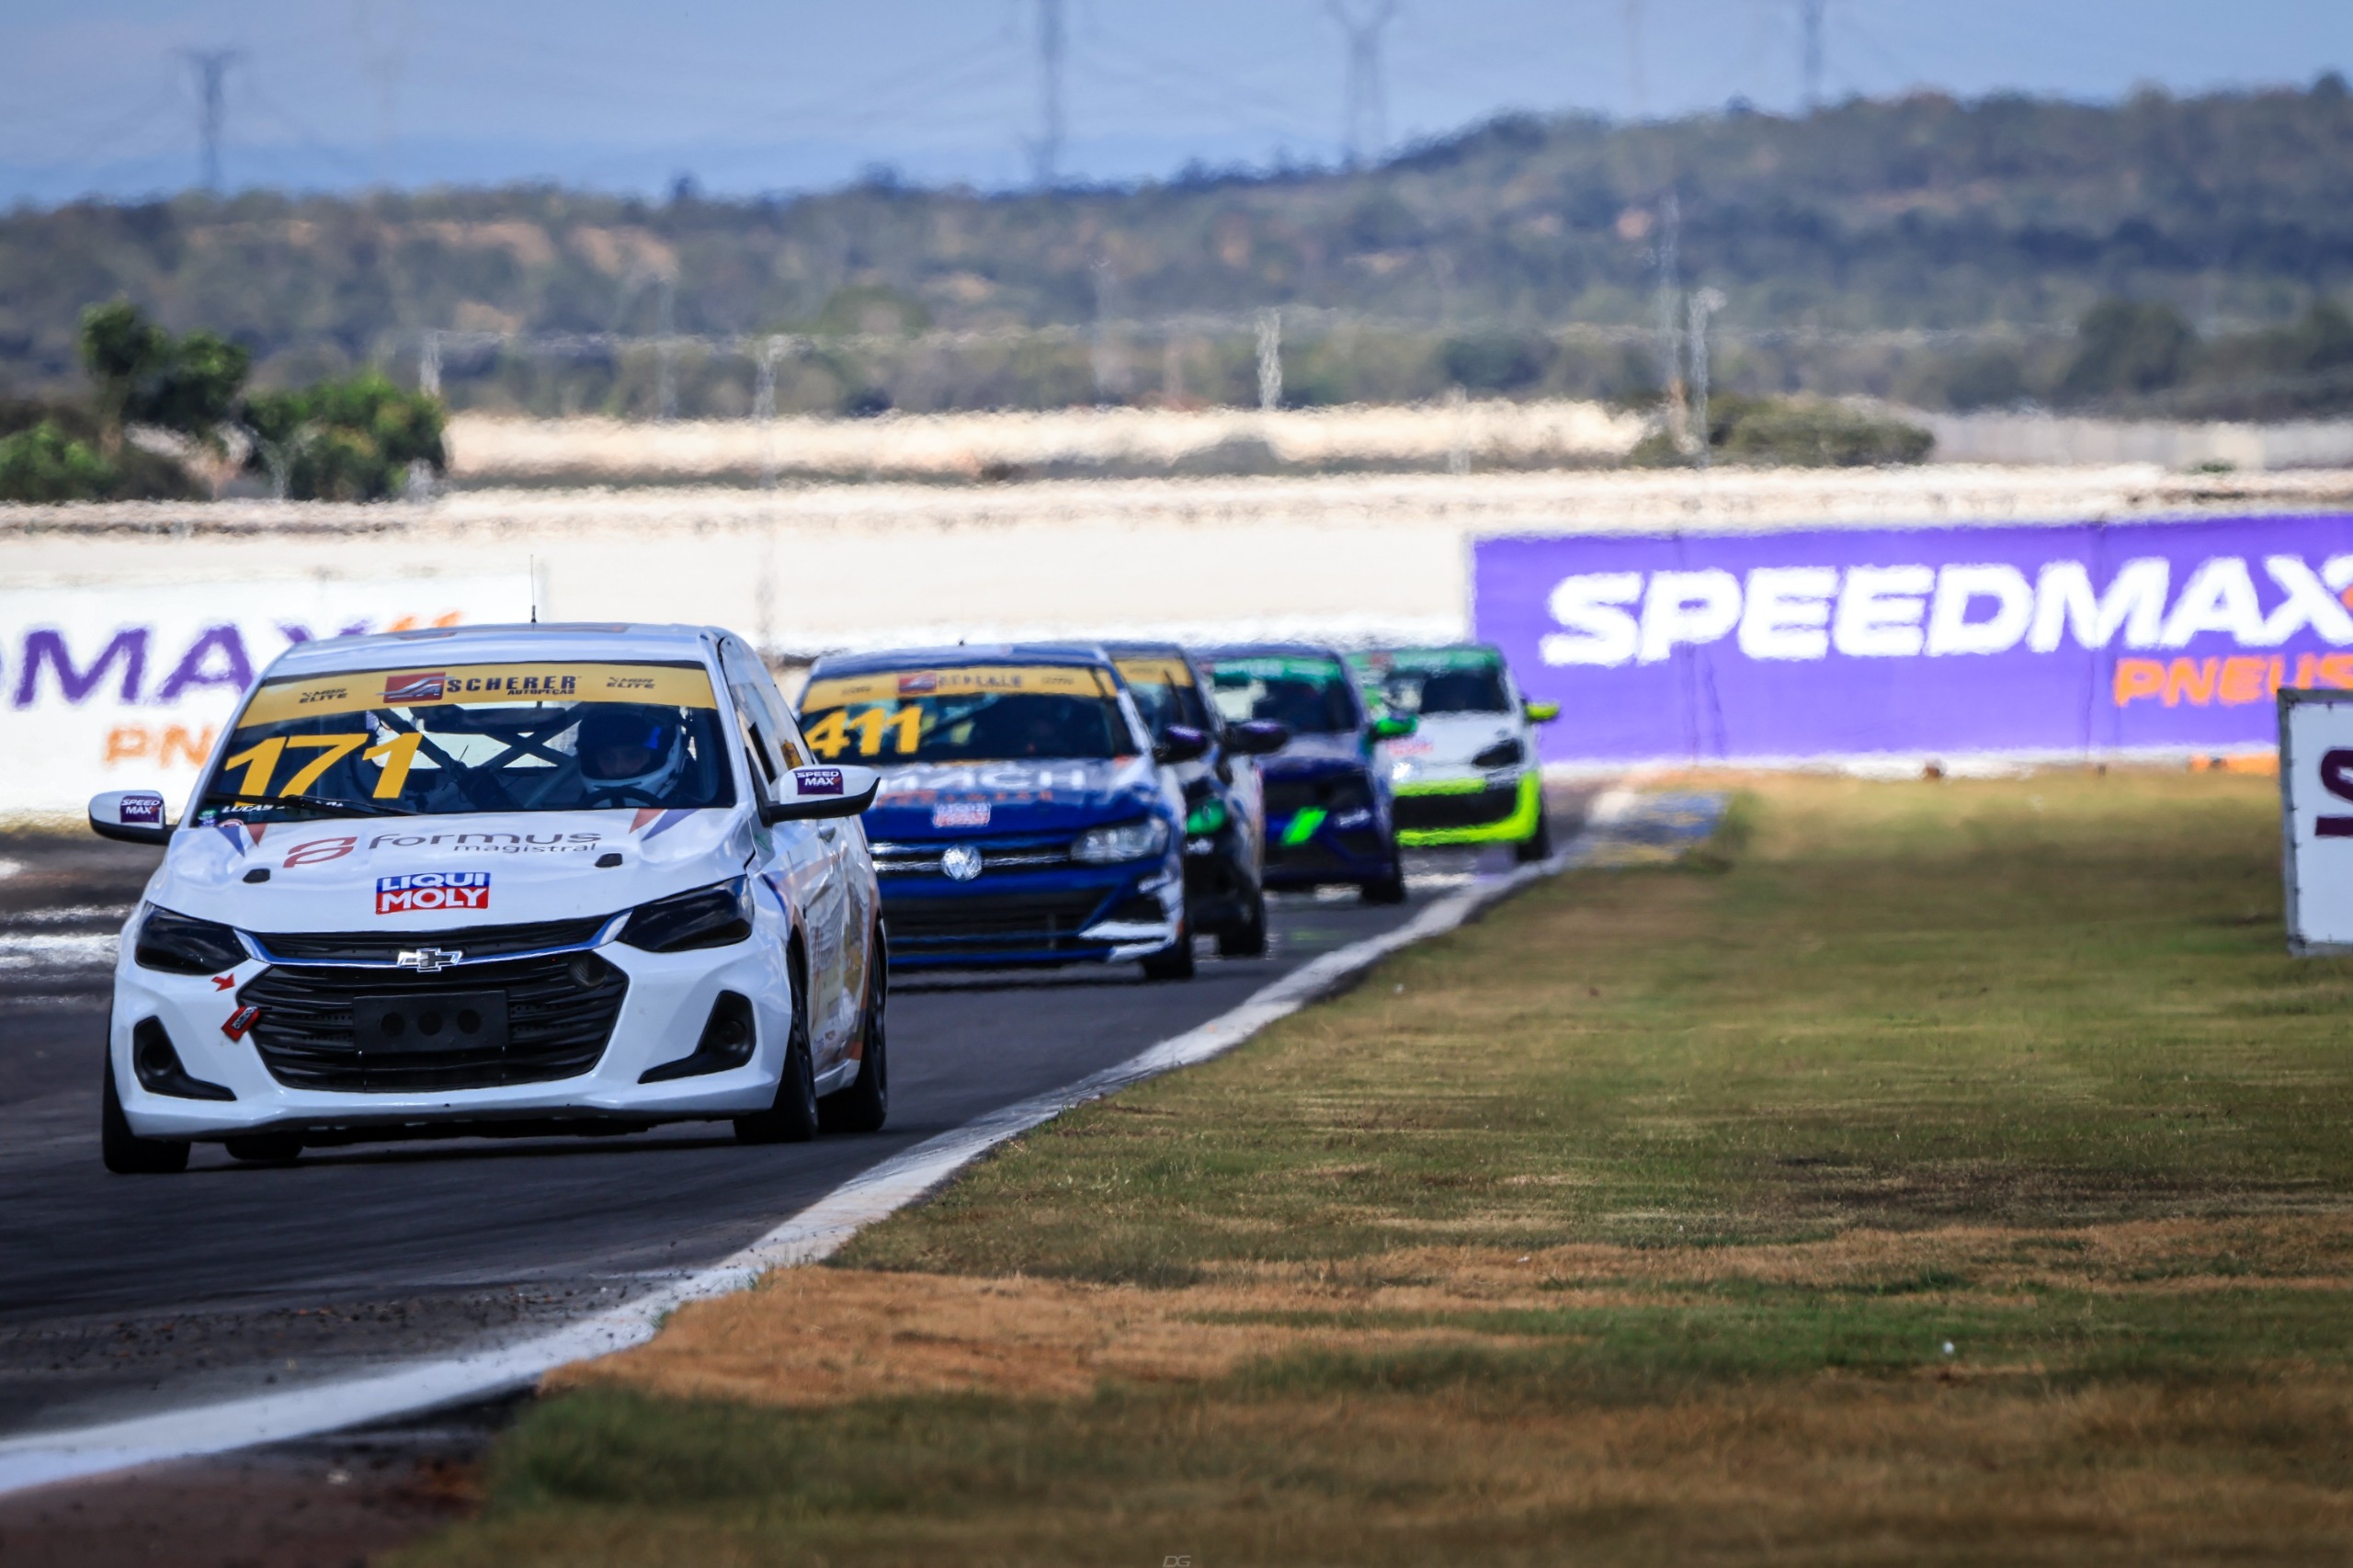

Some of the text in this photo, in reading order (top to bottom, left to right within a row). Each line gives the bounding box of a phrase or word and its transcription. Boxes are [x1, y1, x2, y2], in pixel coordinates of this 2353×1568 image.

[1540, 553, 2353, 666] SPEEDMAX
[447, 676, 577, 693] SCHERER
[299, 692, 348, 704] ELITE
[803, 704, 923, 758] 411
[224, 732, 424, 807] 171
[804, 777, 835, 786] MAX
[125, 806, 152, 814] MAX
[221, 804, 274, 813] LUCAS
[369, 833, 602, 850] formus
[453, 843, 596, 854] magistral
[381, 872, 486, 892] LIQUI
[381, 887, 488, 913] MOLY
